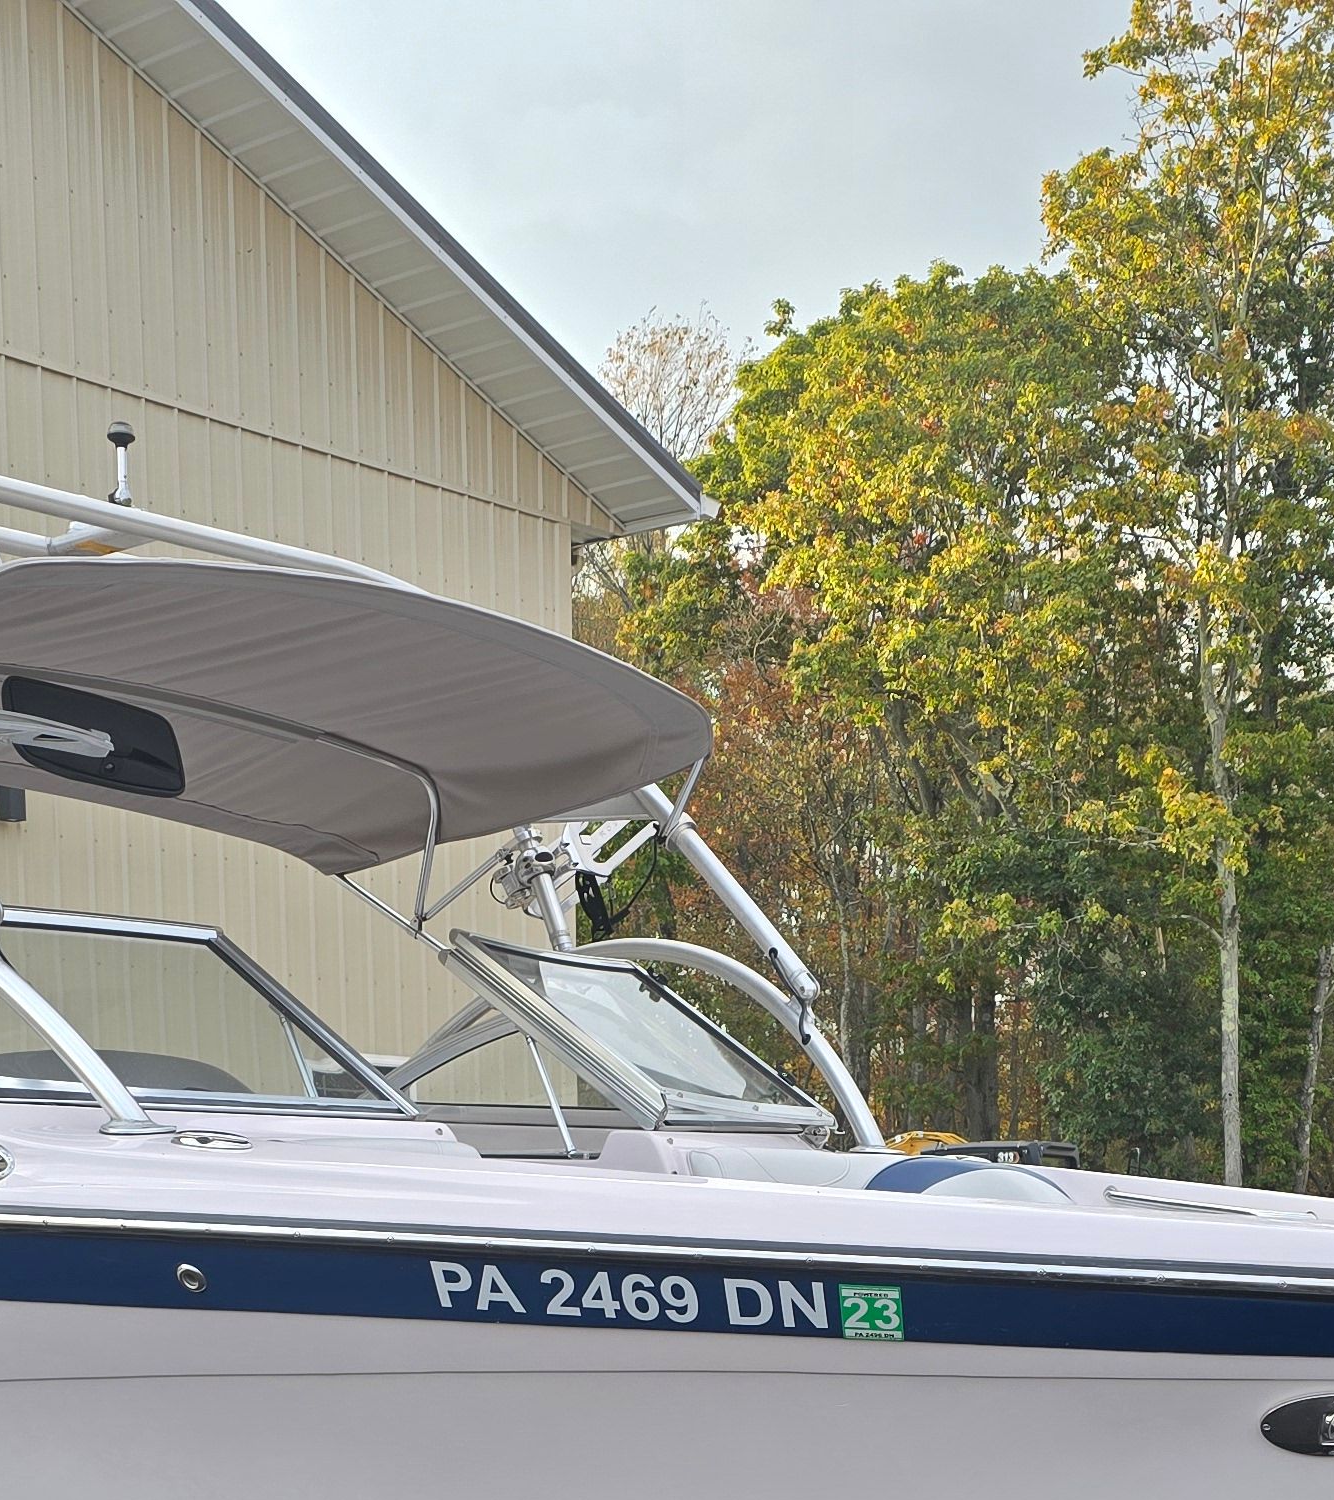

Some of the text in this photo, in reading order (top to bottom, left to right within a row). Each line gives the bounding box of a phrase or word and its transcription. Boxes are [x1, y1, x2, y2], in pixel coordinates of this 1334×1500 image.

[429, 1260, 829, 1329] PA 2469 DN
[843, 1298, 900, 1330] 23
